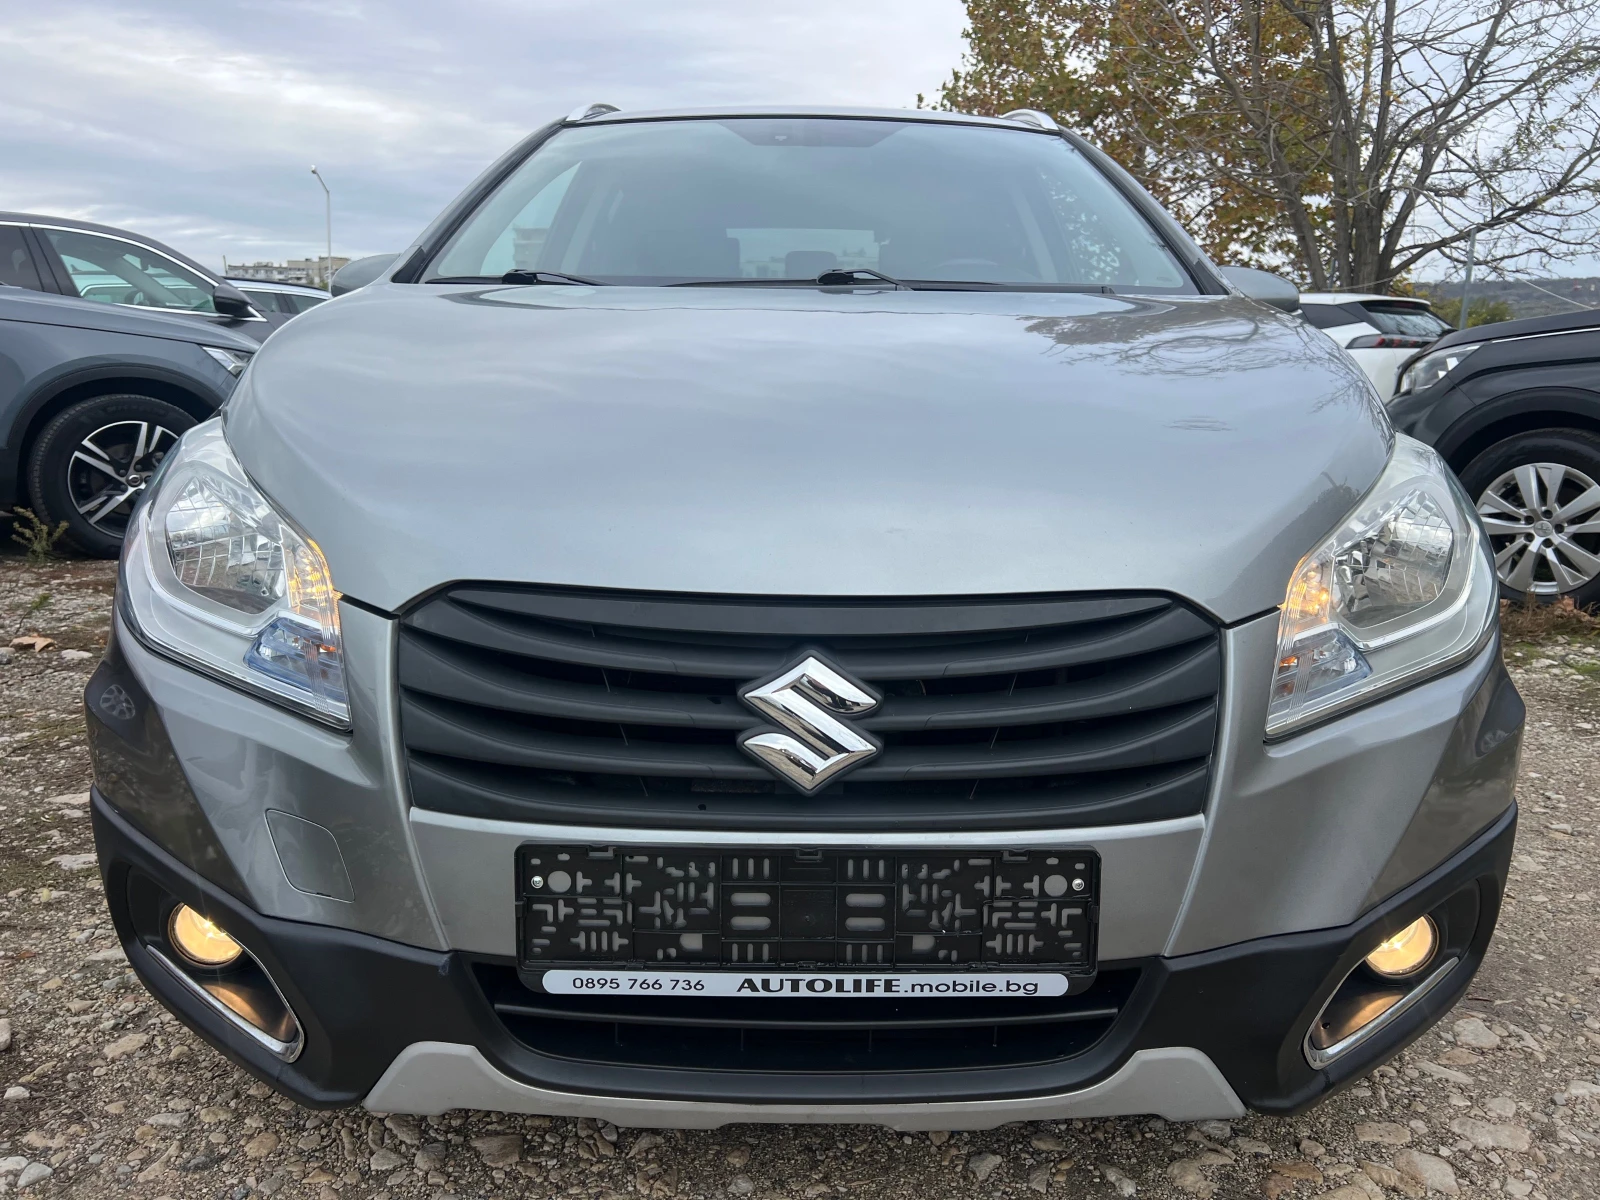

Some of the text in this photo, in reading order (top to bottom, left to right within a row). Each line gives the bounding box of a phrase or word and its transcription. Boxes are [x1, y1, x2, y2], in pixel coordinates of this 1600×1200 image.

[572, 977, 1039, 996] 0895 766 736 AUTOLIFE.mobile.bg
